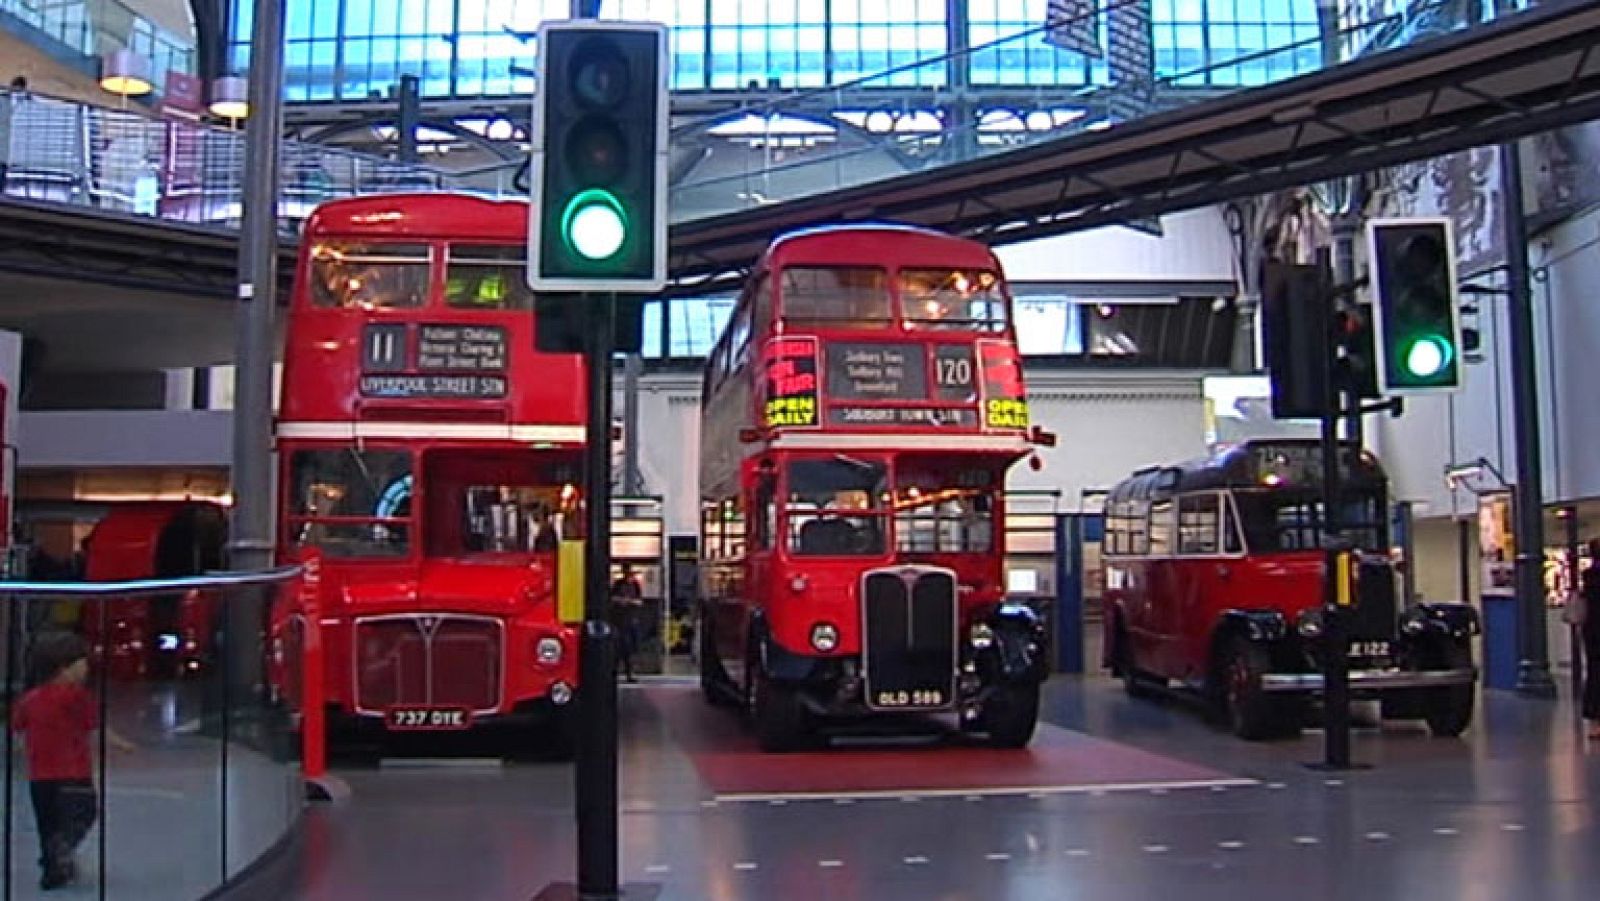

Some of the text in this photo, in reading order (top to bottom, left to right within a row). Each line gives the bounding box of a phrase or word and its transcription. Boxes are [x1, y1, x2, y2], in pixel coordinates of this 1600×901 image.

[373, 332, 393, 363] 11
[936, 358, 970, 385] 120
[431, 376, 475, 393] STREET
[395, 710, 426, 725] 737
